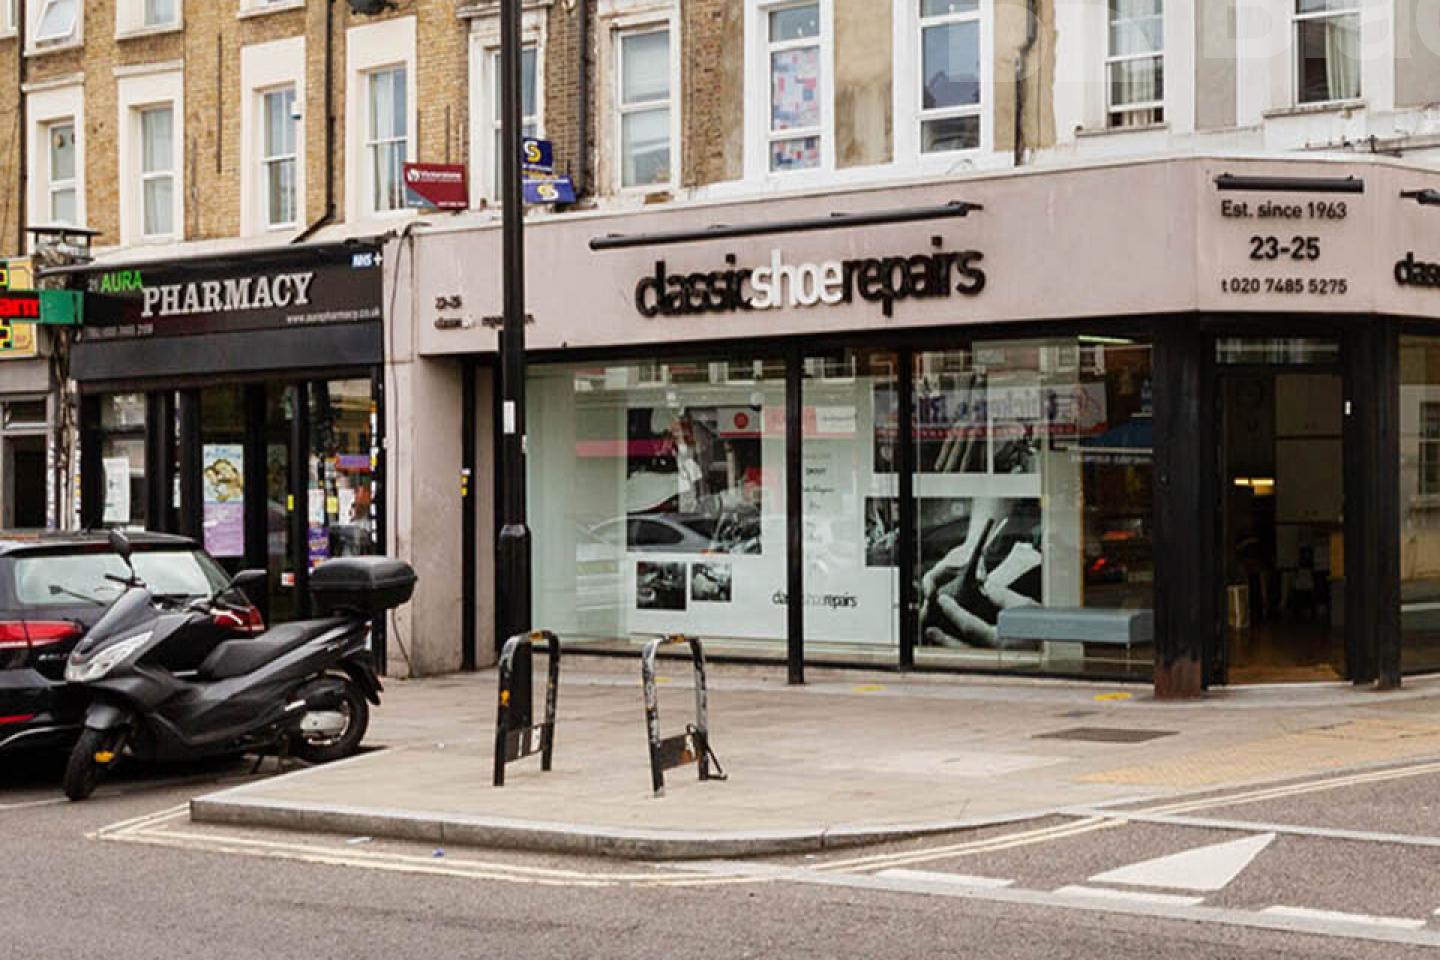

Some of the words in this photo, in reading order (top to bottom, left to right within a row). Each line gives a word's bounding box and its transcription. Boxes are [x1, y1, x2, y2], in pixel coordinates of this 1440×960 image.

[1221, 199, 1254, 218] Est.
[1257, 200, 1302, 218] since
[1308, 201, 1347, 219] 1963
[1250, 236, 1321, 260] 23-25
[101, 271, 143, 292] AURA
[635, 236, 986, 318] classicshoerepairs
[1265, 278, 1304, 294] 7485
[1308, 279, 1348, 295] 5275
[141, 272, 313, 318] PHARMACY
